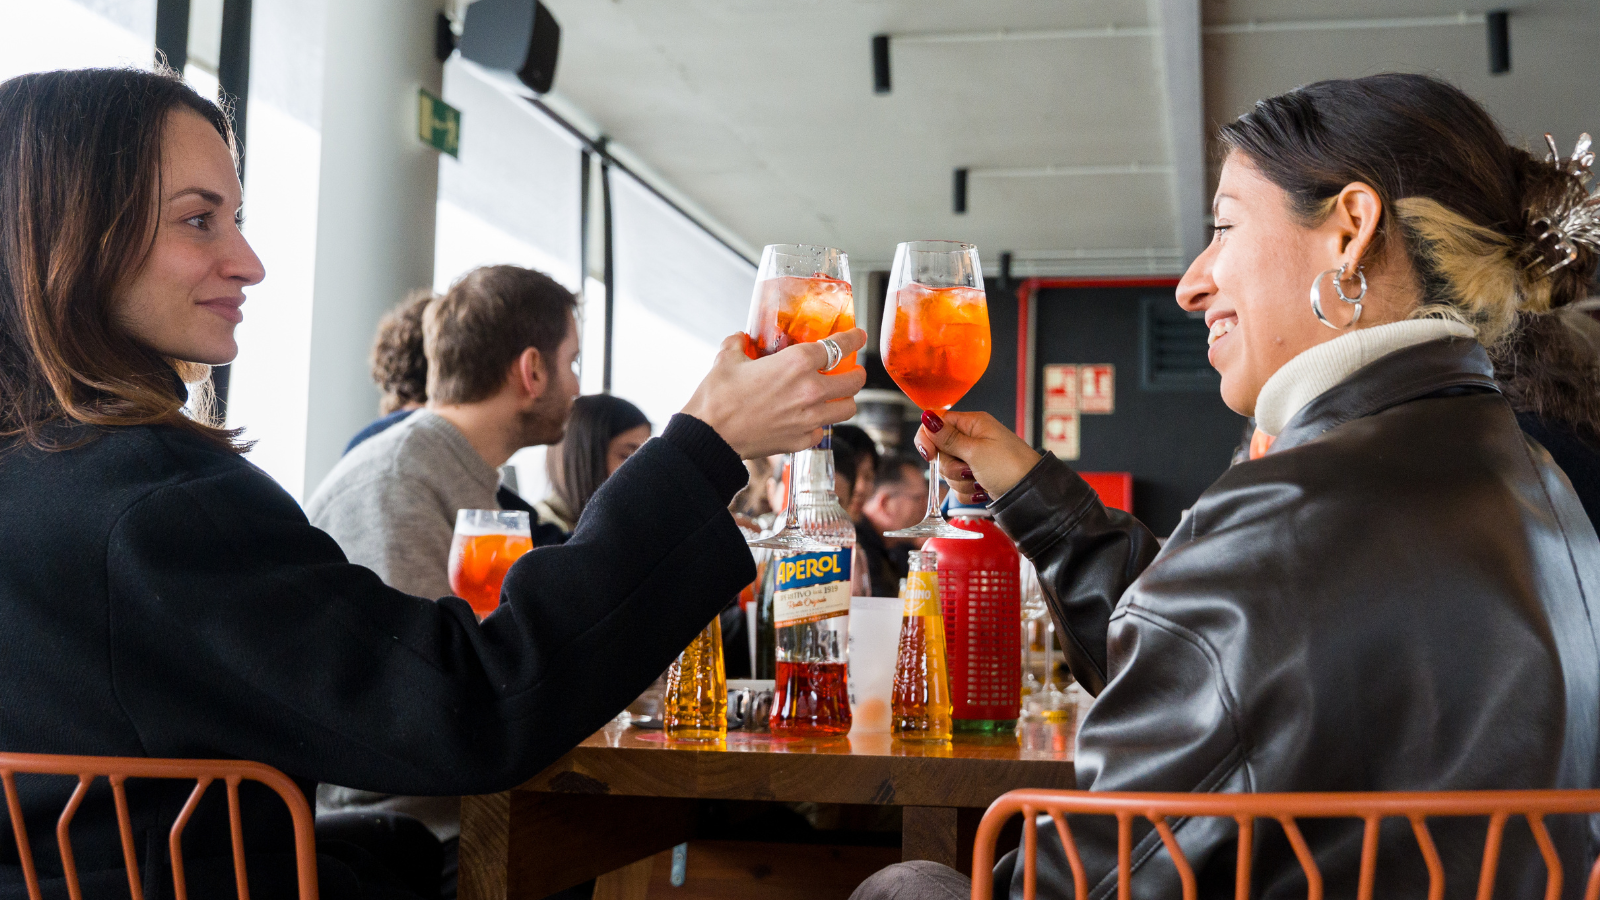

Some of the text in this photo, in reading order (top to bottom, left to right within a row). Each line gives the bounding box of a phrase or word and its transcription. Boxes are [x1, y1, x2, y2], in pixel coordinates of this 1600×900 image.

[776, 554, 841, 585] APEROL
[779, 589, 811, 601] PERITIVO
[824, 585, 838, 594] 1919
[905, 589, 931, 600] ODINO
